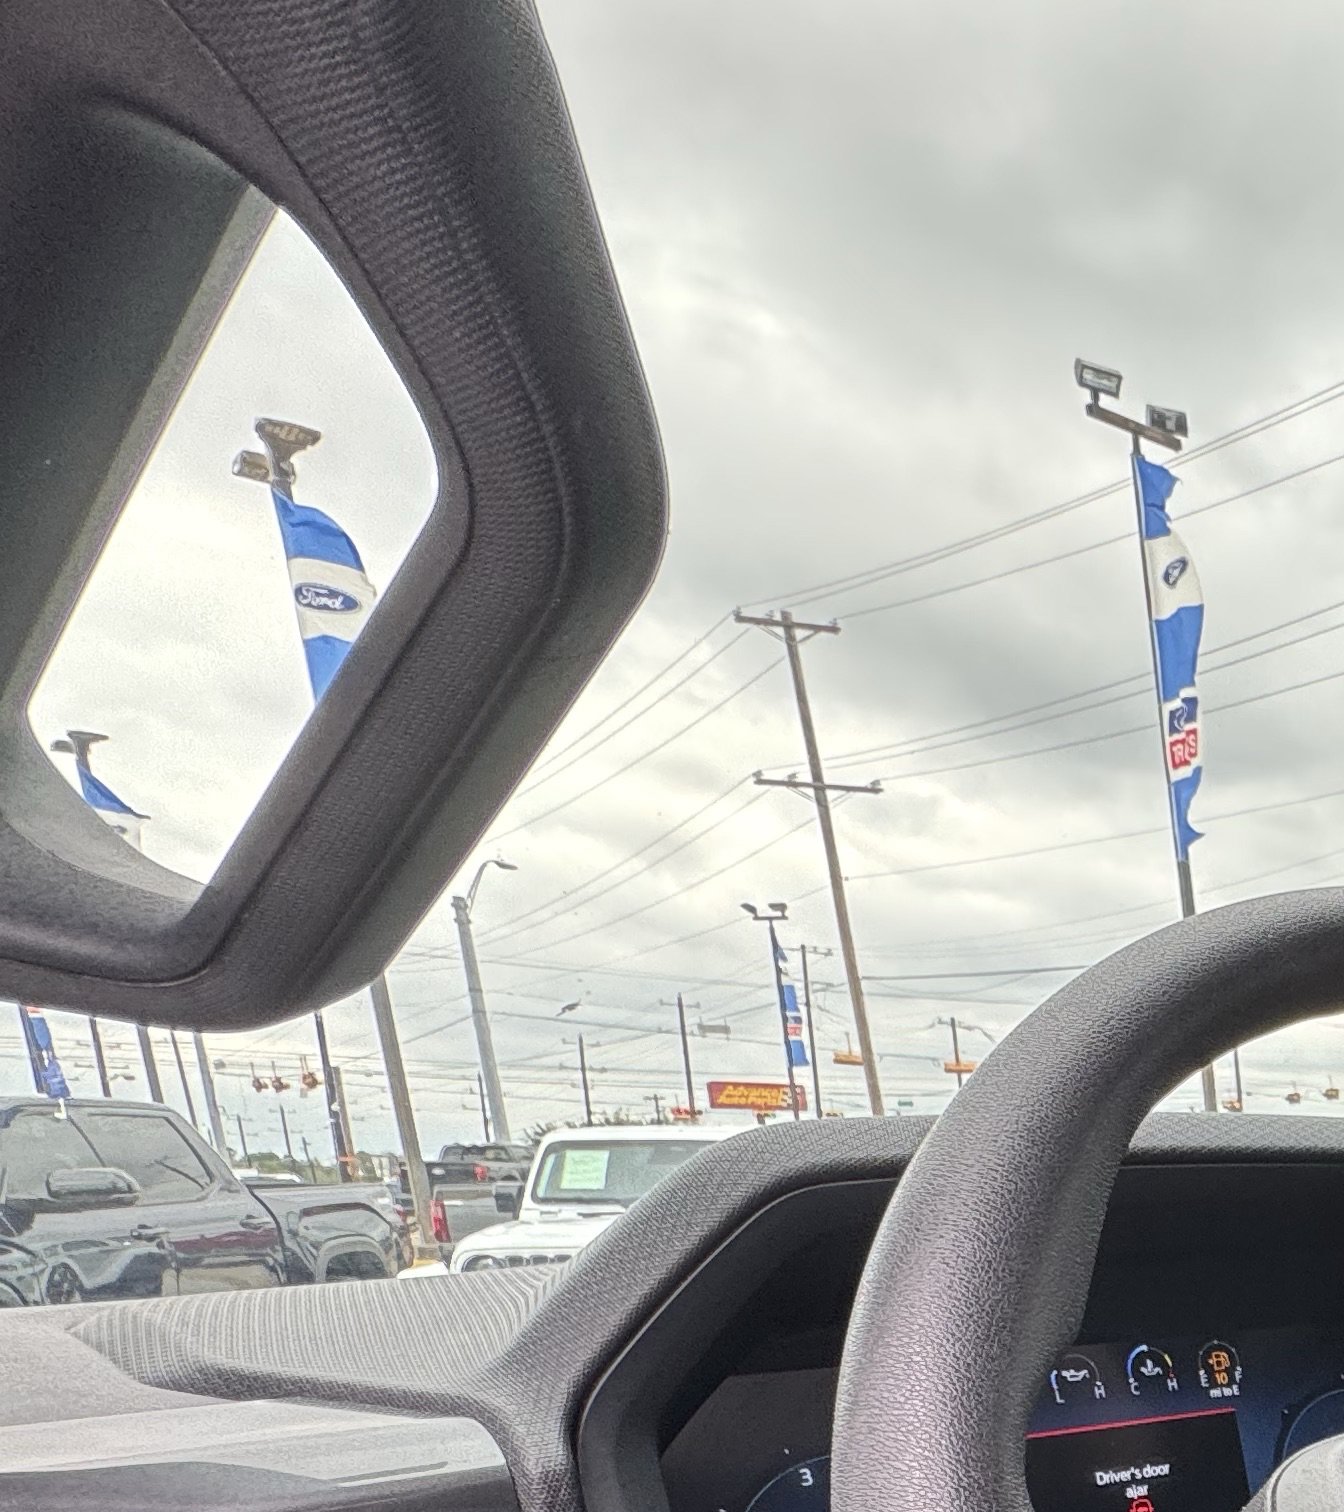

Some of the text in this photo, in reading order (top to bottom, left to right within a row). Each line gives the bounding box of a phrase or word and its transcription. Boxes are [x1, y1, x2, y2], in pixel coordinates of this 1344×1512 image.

[298, 586, 345, 610] Ford
[1214, 1371, 1229, 1385] 10
[799, 1468, 814, 1487] 3
[1095, 1464, 1170, 1486] Driver's door
[1125, 1484, 1149, 1499] ajar
